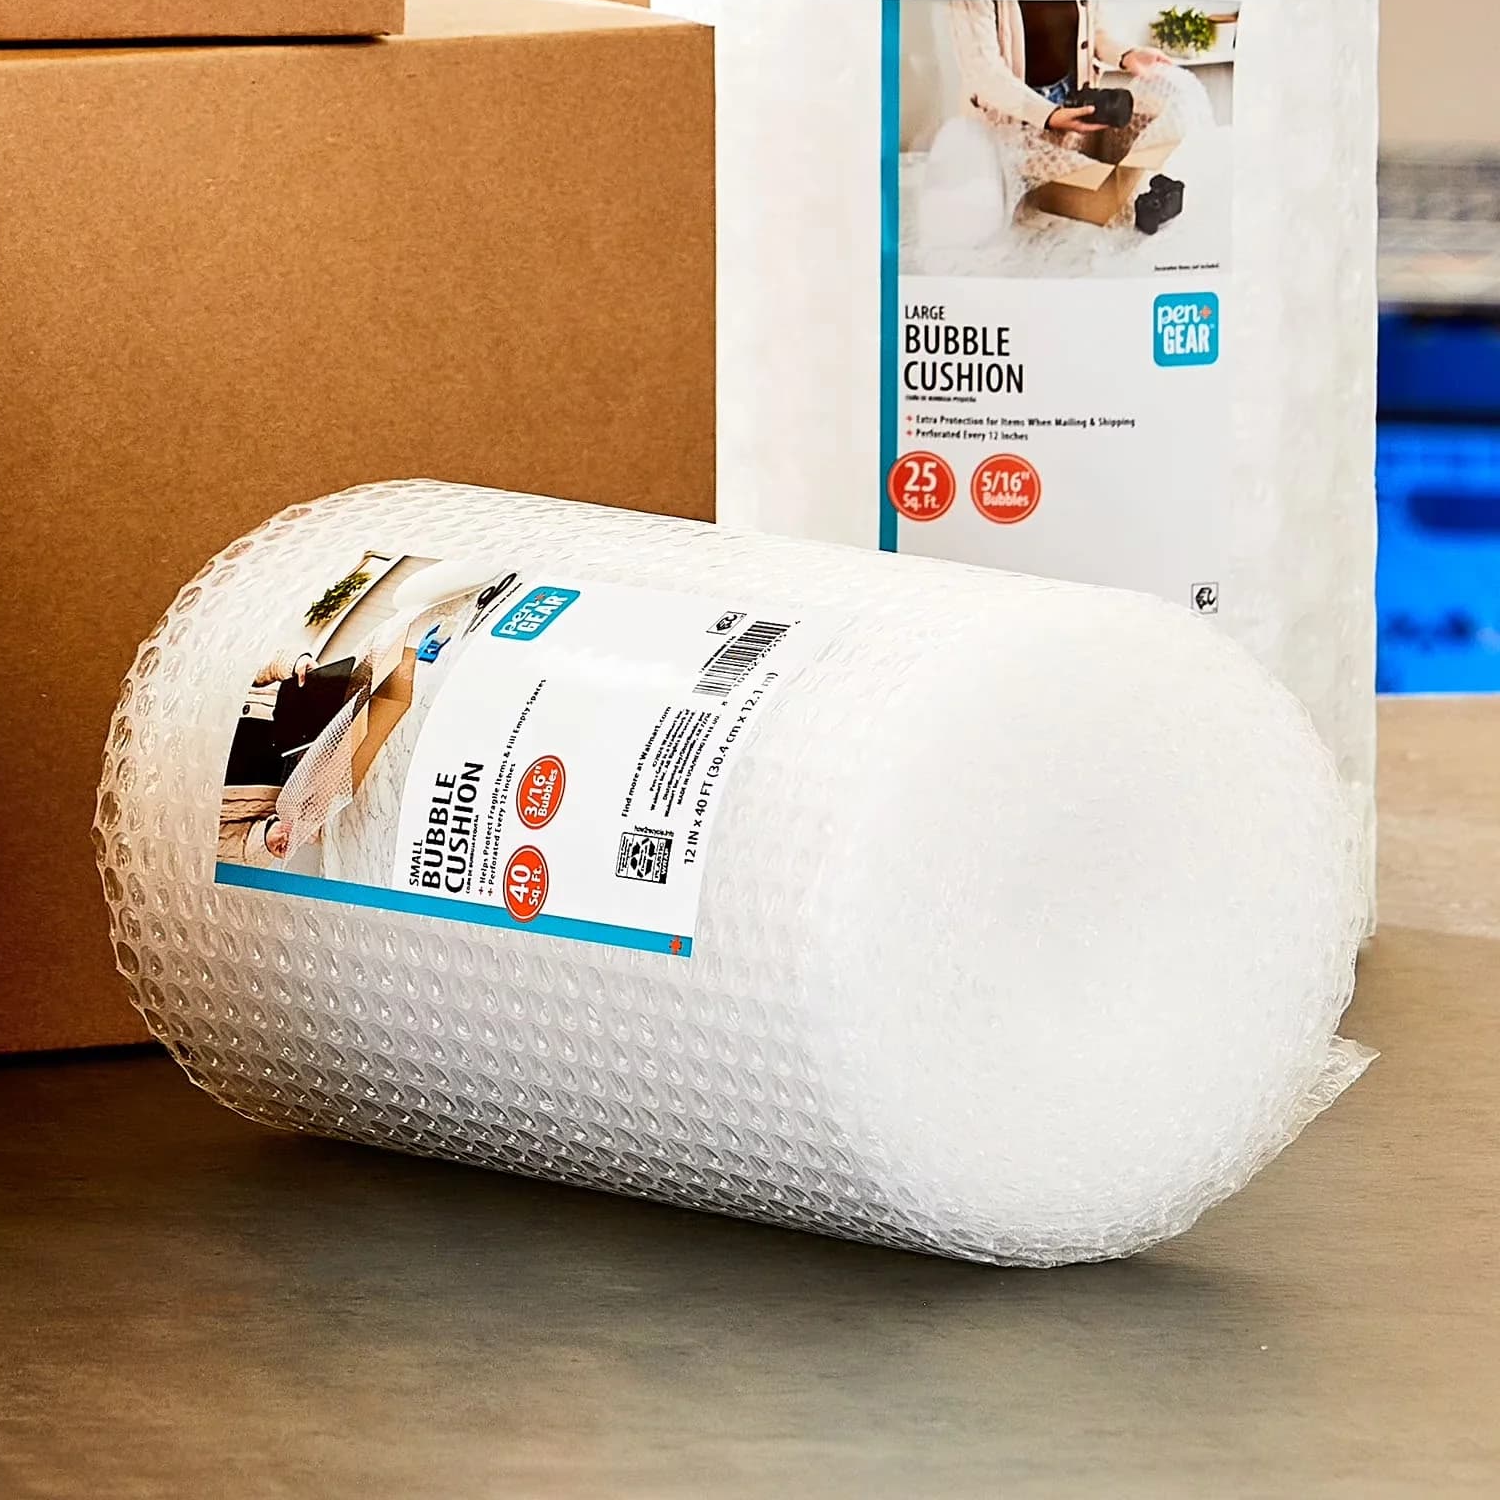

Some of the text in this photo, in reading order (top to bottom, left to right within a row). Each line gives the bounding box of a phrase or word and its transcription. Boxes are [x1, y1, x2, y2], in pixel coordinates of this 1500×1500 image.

[905, 304, 945, 320] LARGE
[905, 324, 1010, 356] BUBBLE
[1163, 324, 1210, 355] GEAR
[904, 361, 1023, 393] CUSHION
[916, 414, 1135, 428] Extra Protection for Items When Mailing & Shipping
[916, 429, 1028, 442] Perforated Every 12 Inches
[904, 461, 937, 492] 25
[981, 471, 1030, 492] 5/16"
[903, 493, 940, 511] Sq. Ft.
[982, 492, 1029, 507] Bubbles
[516, 596, 568, 632] GEAR
[526, 679, 546, 705] Spaces
[513, 707, 531, 733] Empty
[506, 735, 517, 749] Fill
[494, 760, 508, 786] Items
[621, 706, 672, 818] Find more at Walmart.com
[684, 672, 779, 865] 12 IN x 40 FT (30.4 cm x 12.1 m)
[488, 787, 500, 820] Fragile
[524, 765, 546, 818] 3/16"
[538, 768, 558, 817] Bubbles
[422, 773, 457, 889] BUBBLE
[445, 762, 484, 893] CUSHION
[483, 822, 493, 856] Protect
[488, 763, 516, 885] Perforated Every 12 Inches
[409, 839, 423, 886] SMALL
[479, 858, 488, 884] Helps
[509, 863, 531, 904] 40
[529, 865, 543, 906] Sq. Ft.
